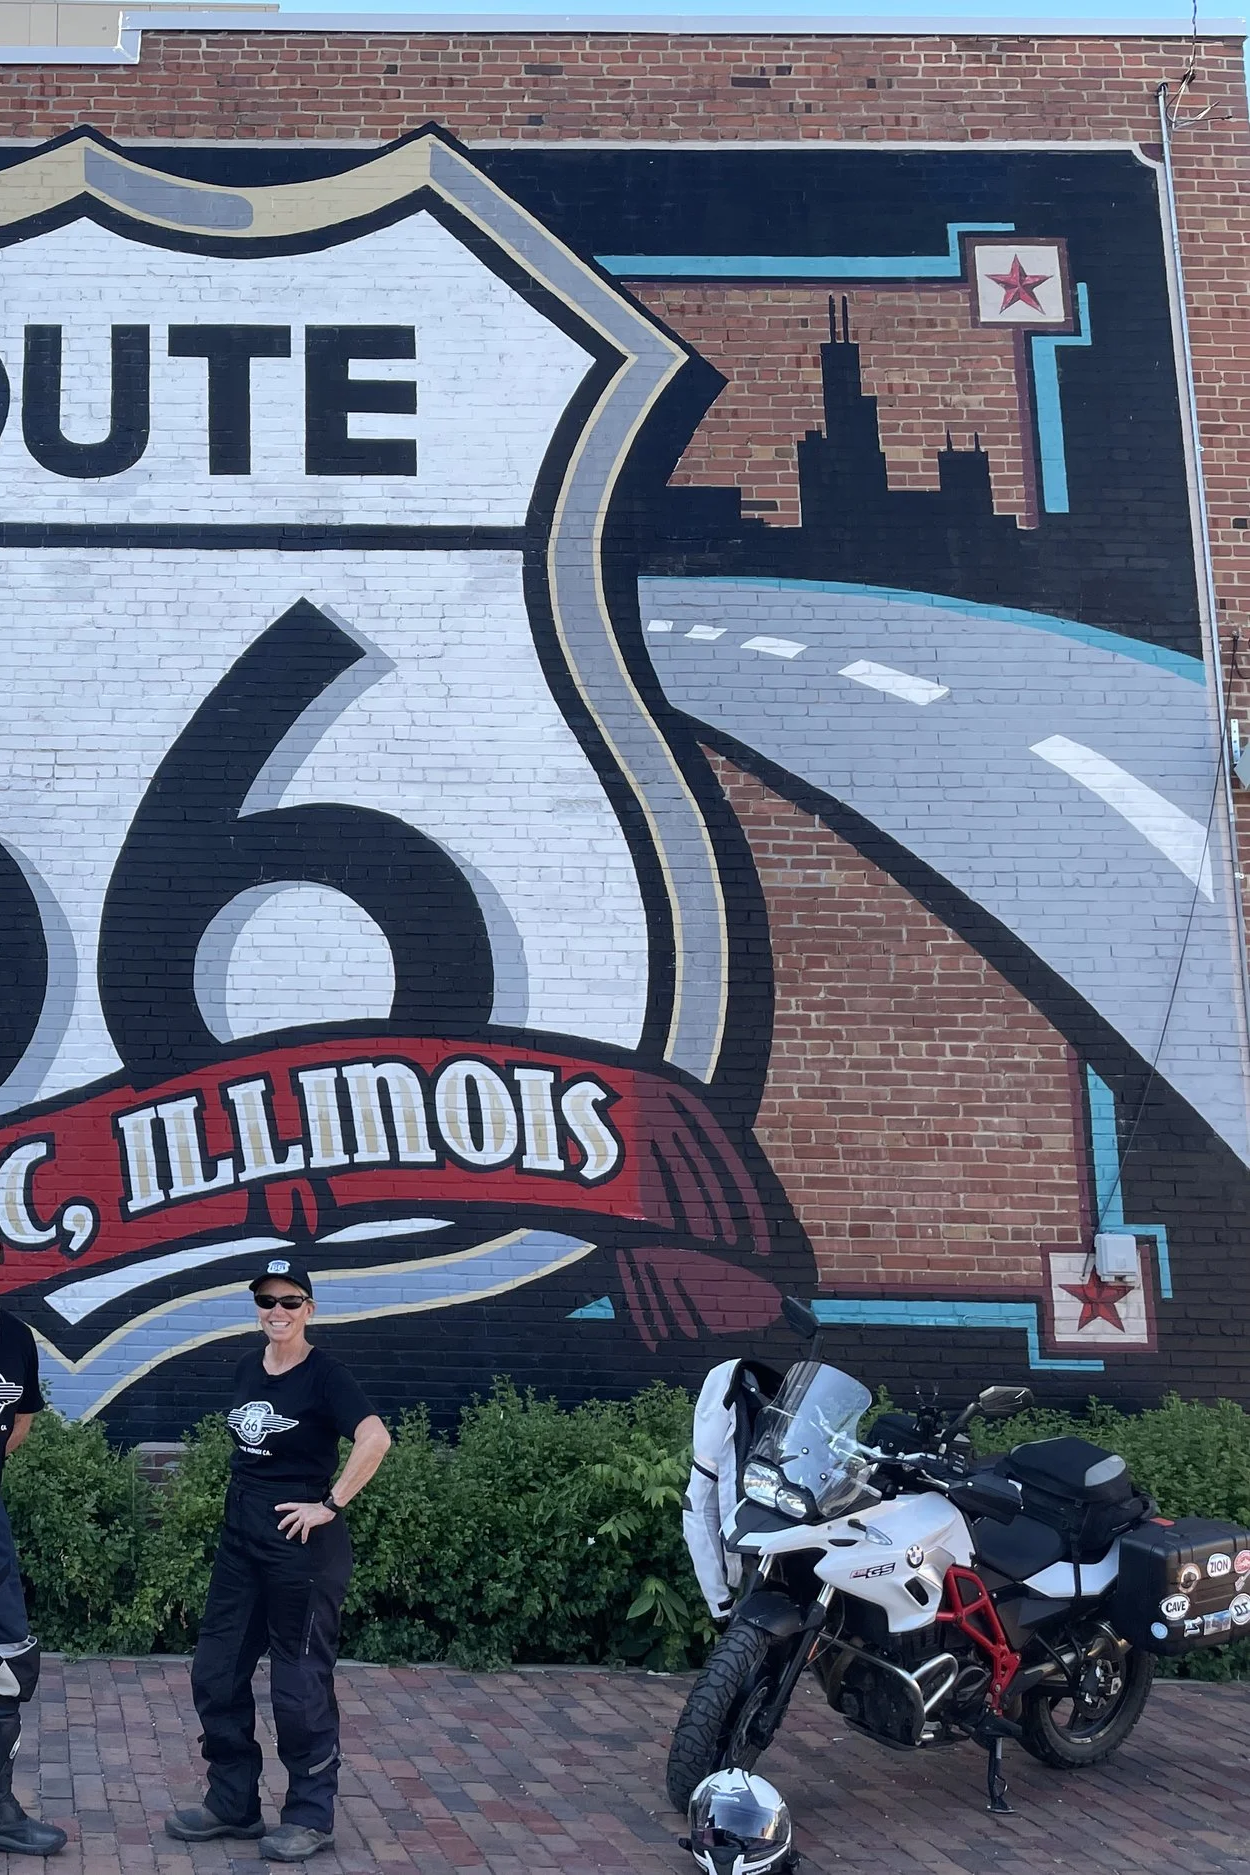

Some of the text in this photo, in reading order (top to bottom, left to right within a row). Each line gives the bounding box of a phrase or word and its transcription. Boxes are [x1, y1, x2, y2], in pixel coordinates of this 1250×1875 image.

[117, 1059, 620, 1213] ILLINOIS
[243, 1418, 258, 1432] 66
[867, 1563, 897, 1577] GS
[1210, 1560, 1229, 1574] ZION
[1165, 1600, 1187, 1613] CAVE
